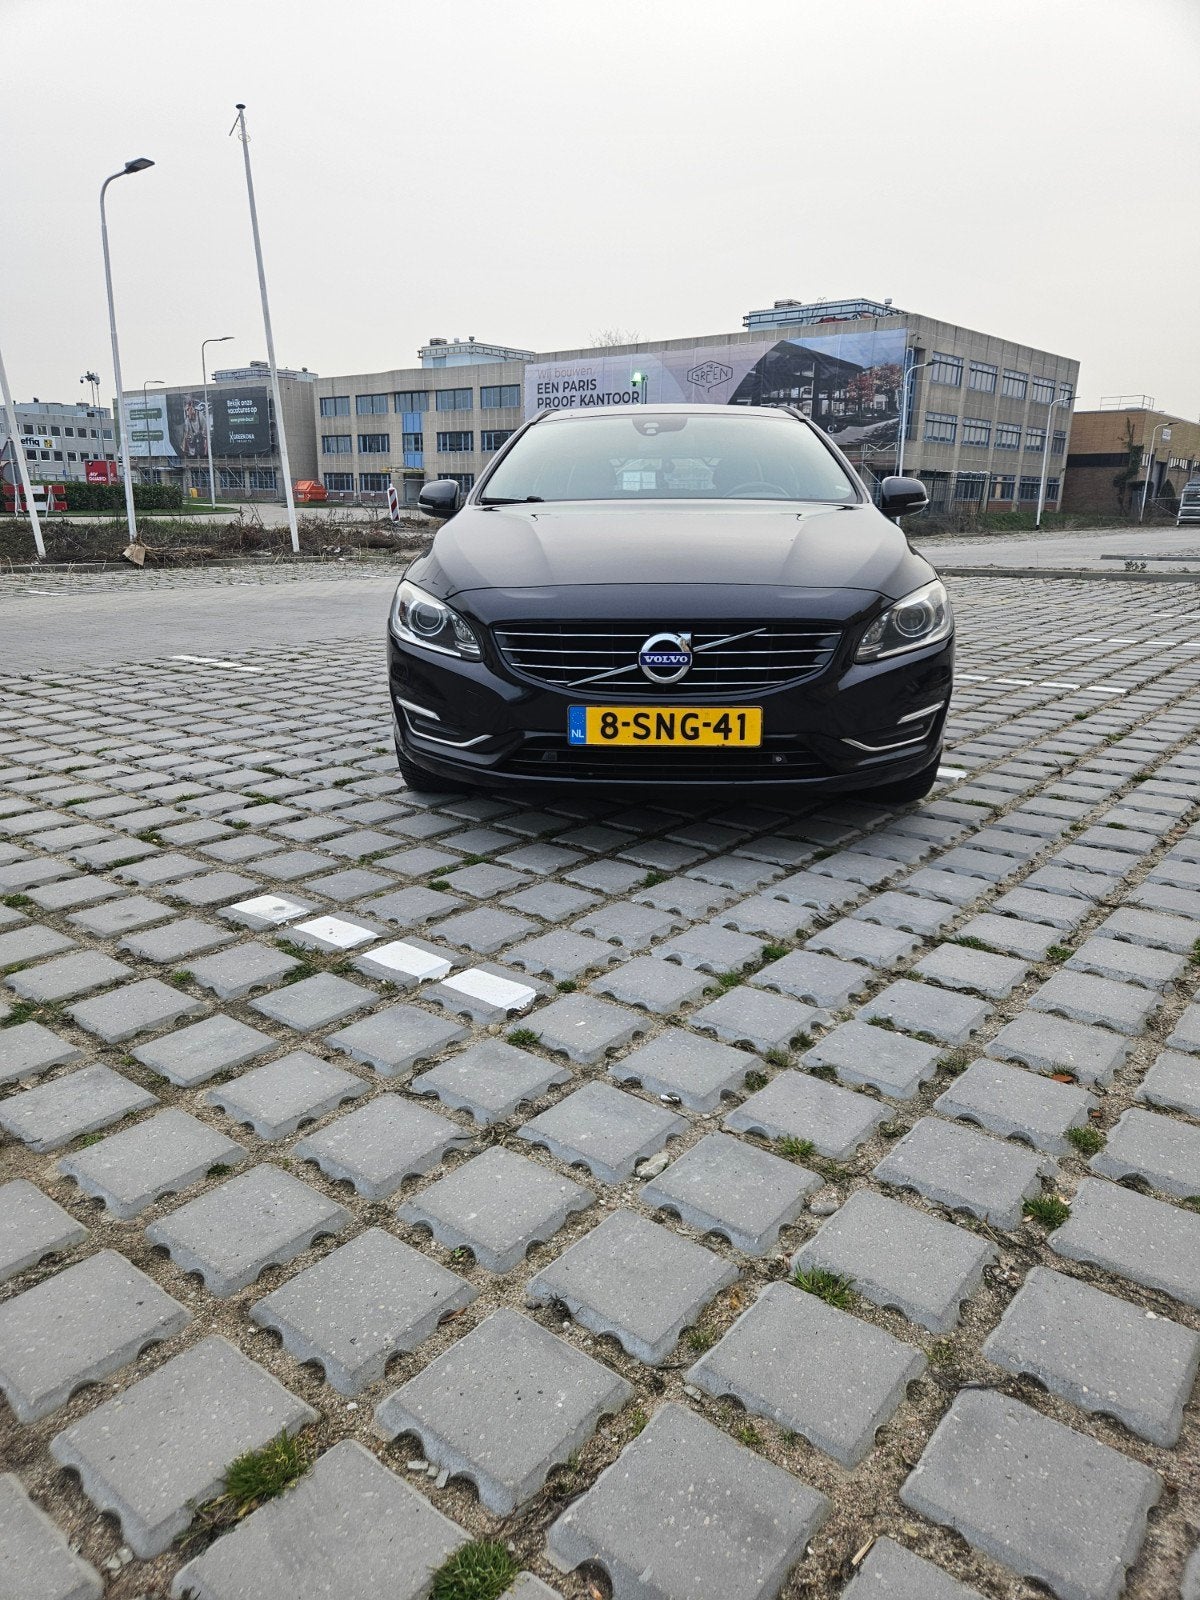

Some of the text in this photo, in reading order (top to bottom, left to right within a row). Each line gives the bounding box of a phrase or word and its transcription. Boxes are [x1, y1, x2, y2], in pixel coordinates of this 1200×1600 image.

[537, 367, 593, 380] Wij bouwen
[691, 366, 728, 383] GREEN
[537, 378, 597, 394] EEN PARIS
[537, 391, 640, 409] PROOF KANTOOR
[20, 437, 40, 447] effiq
[643, 655, 688, 663] VOLVO
[571, 711, 746, 741] NL 8-SNG-41
